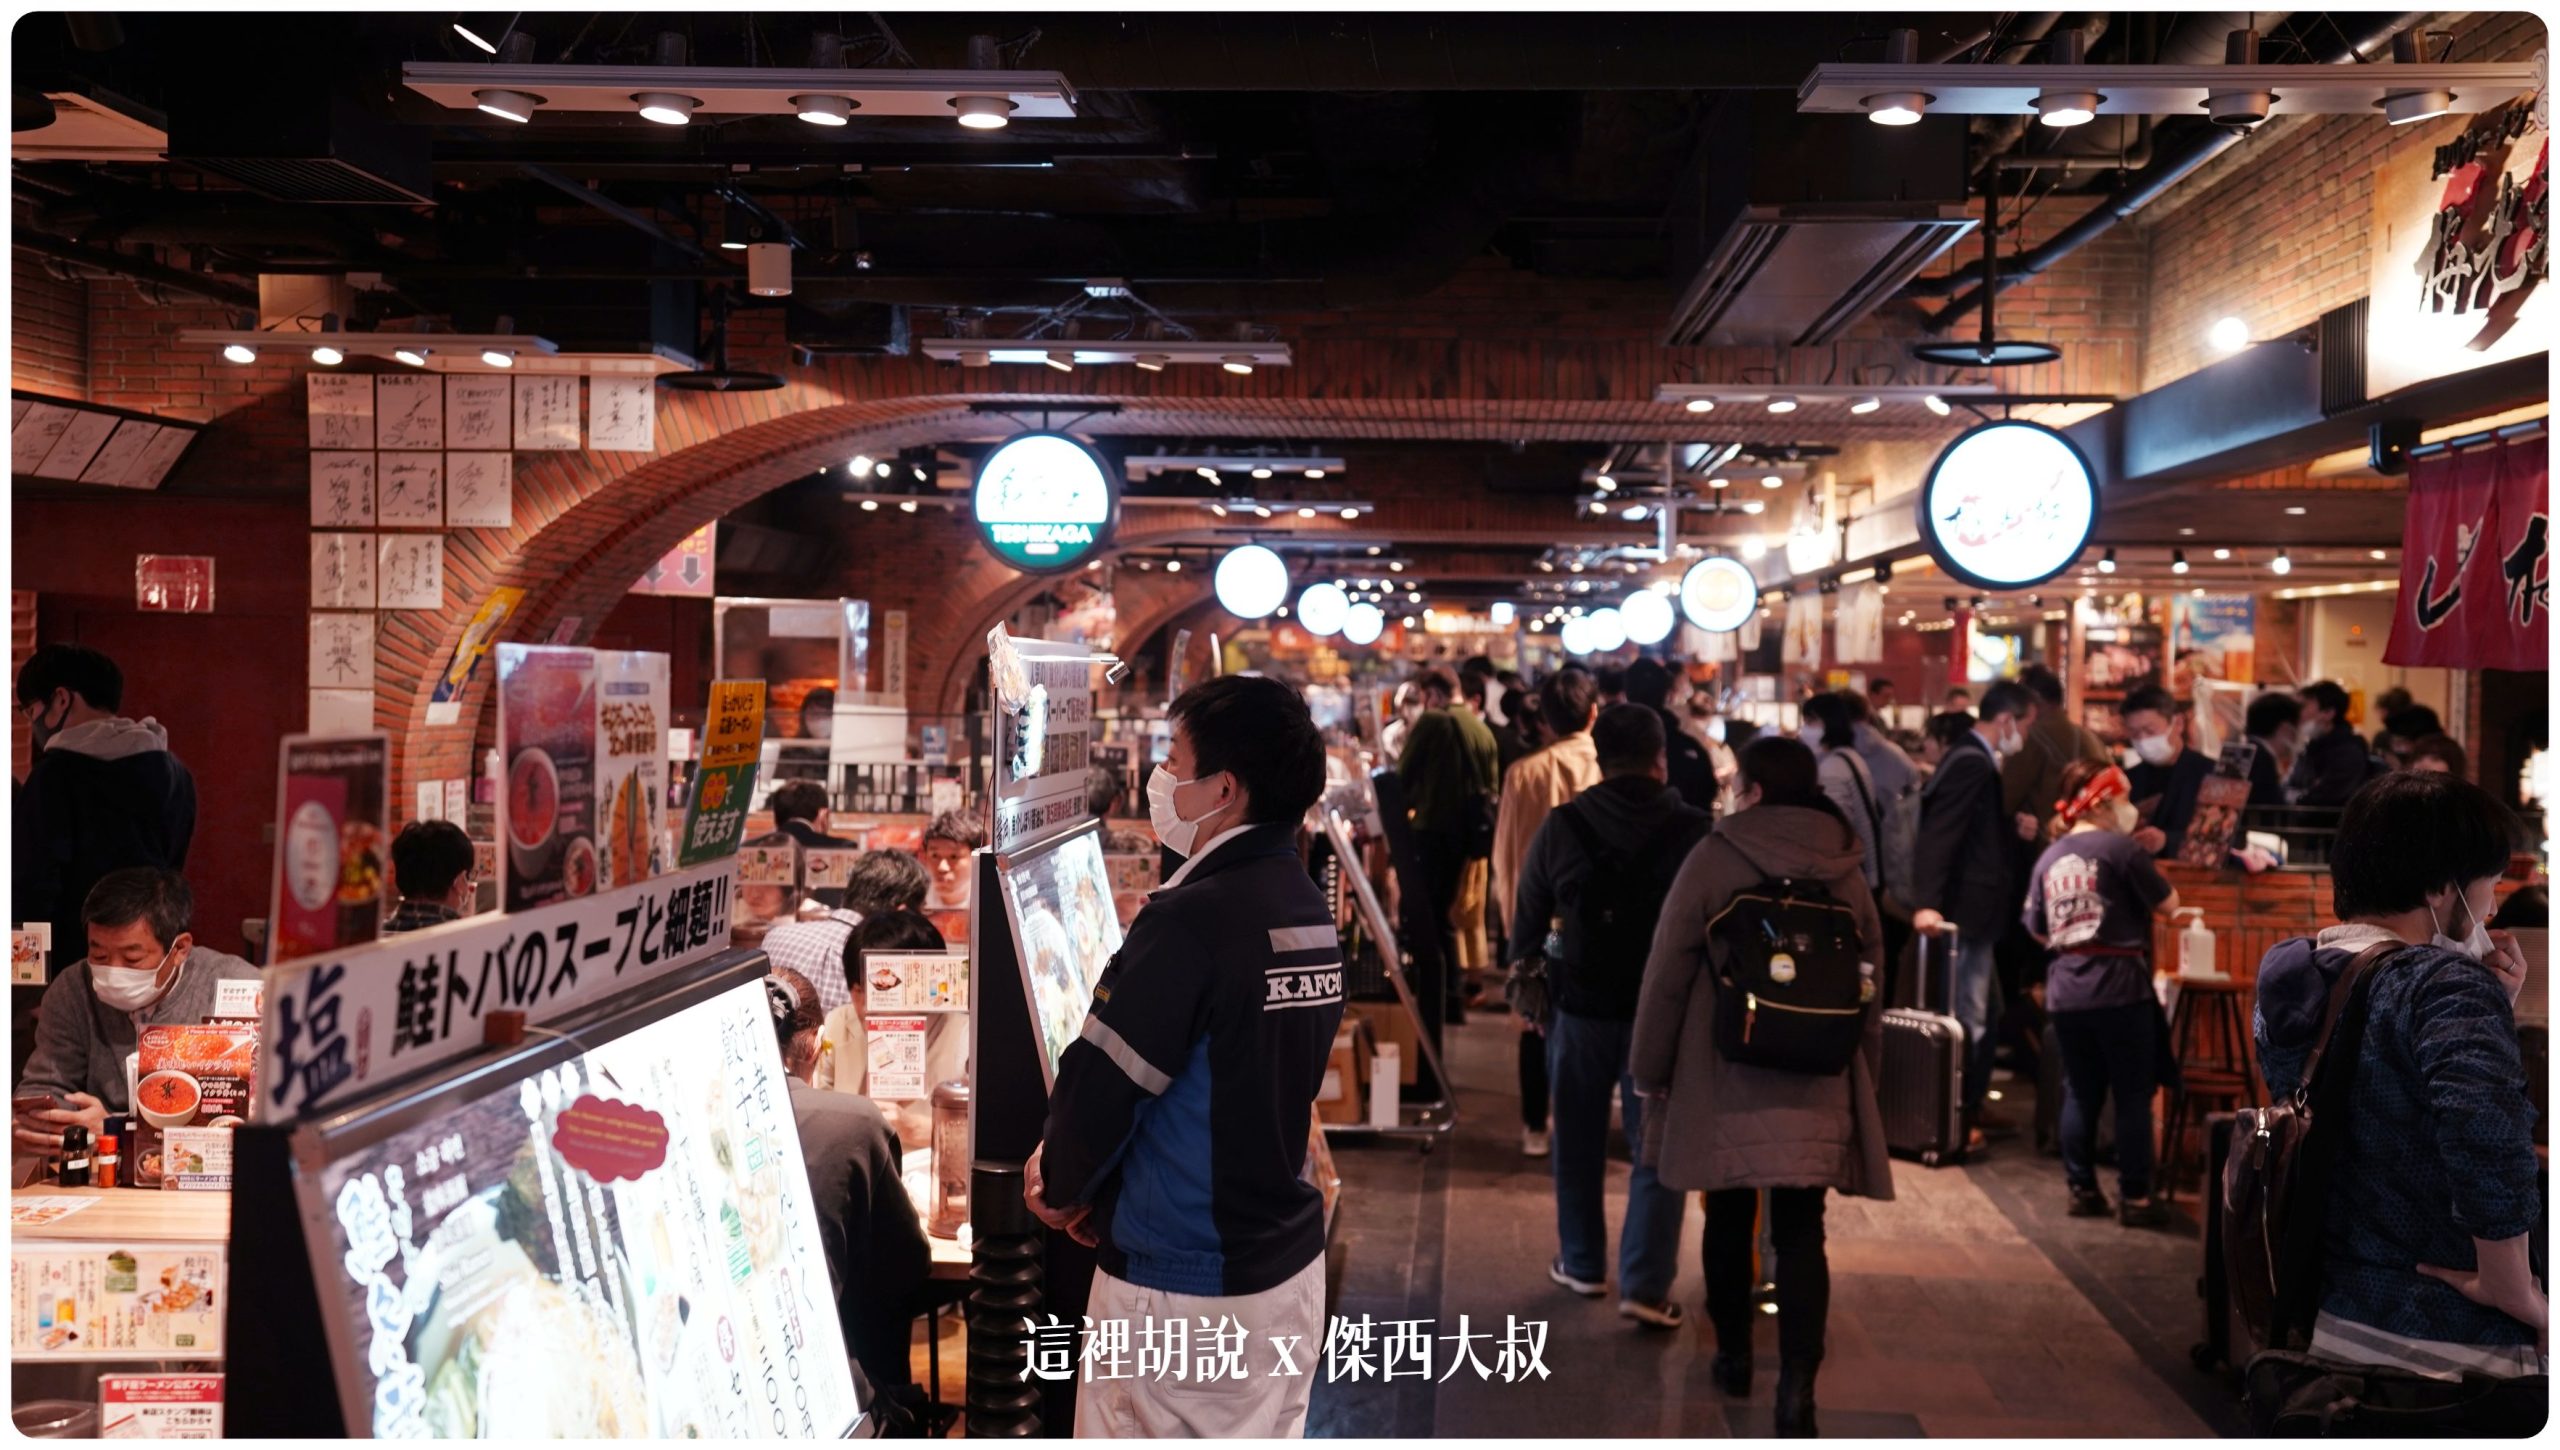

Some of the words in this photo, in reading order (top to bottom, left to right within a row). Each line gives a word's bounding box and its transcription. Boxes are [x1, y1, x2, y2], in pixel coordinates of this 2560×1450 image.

[692, 810, 740, 849] 使えます
[1266, 970, 1343, 1002] KAFCO
[272, 964, 352, 1111] 塩
